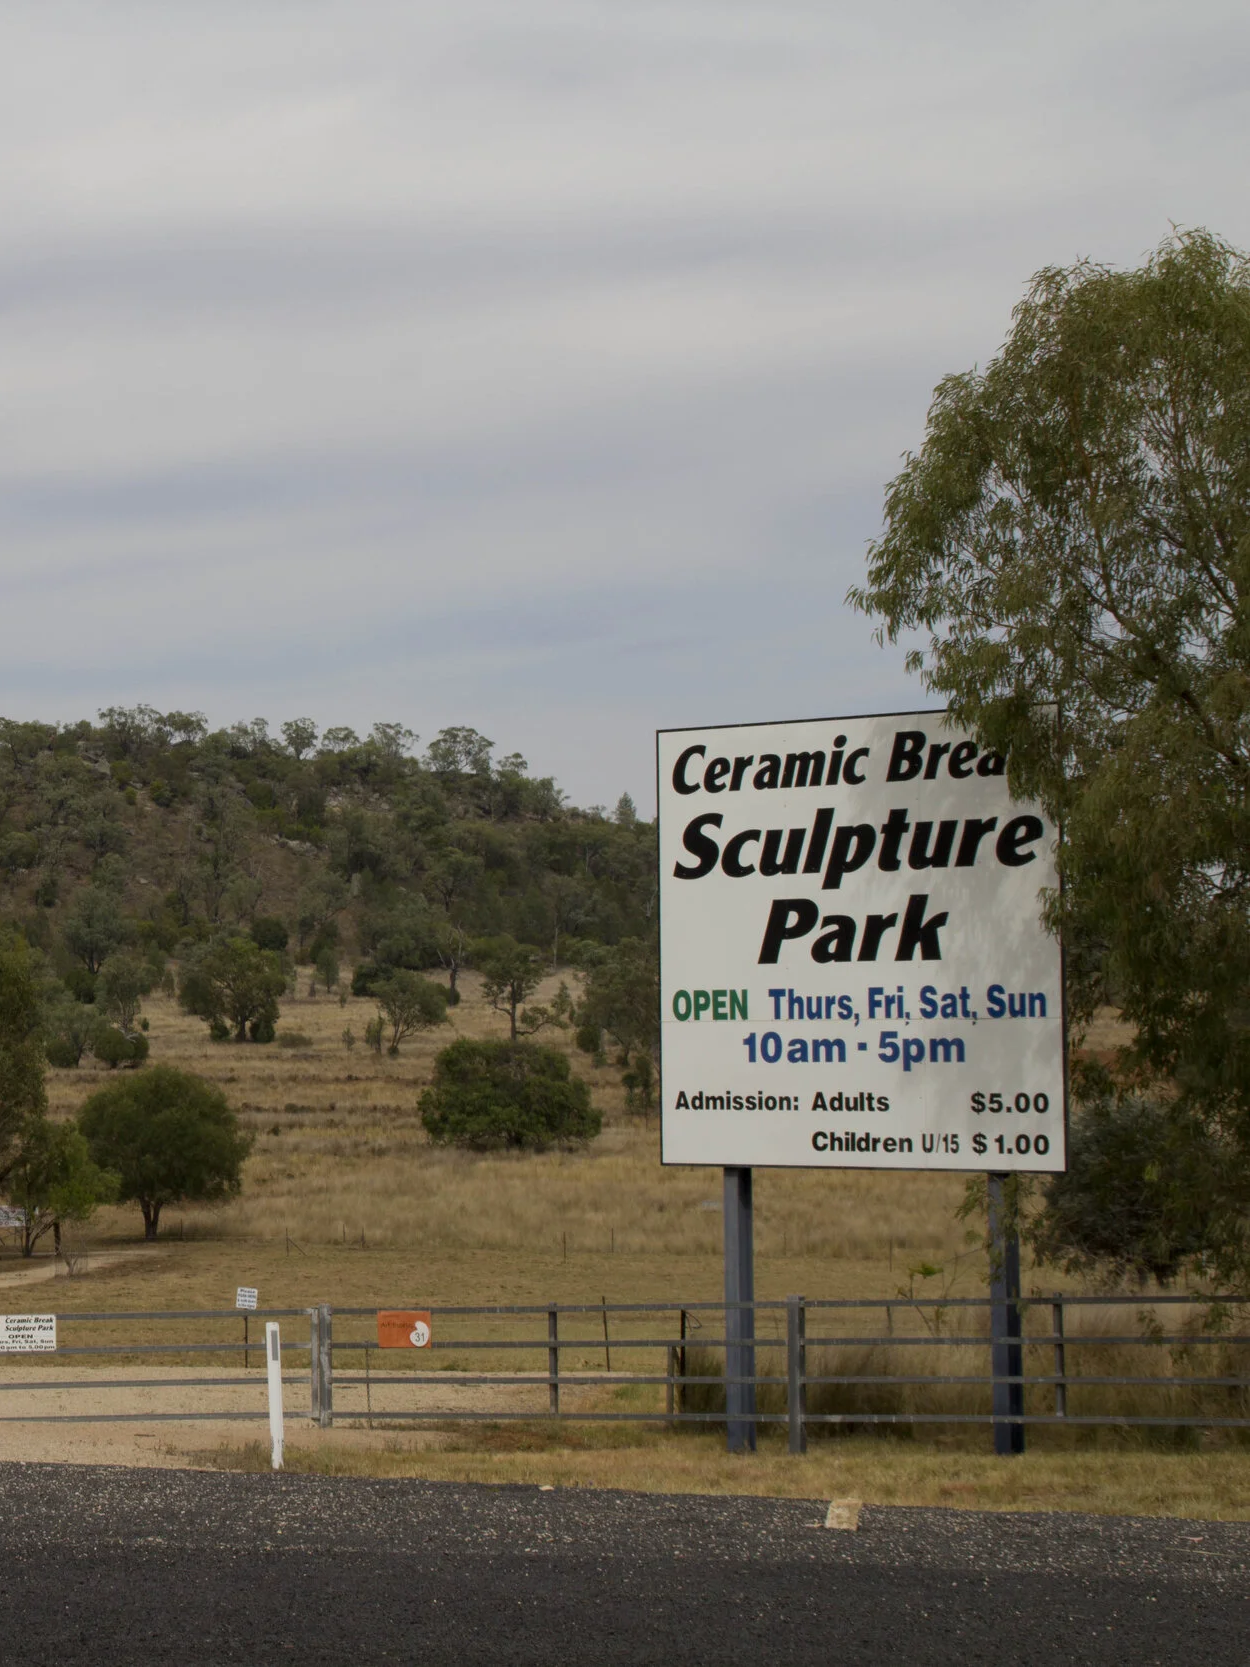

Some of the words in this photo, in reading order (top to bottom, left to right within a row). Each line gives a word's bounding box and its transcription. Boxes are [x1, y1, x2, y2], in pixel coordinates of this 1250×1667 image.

[672, 735, 869, 795] Ceramic
[885, 731, 1007, 783] Brea
[672, 807, 1045, 890] Sculpture
[757, 893, 950, 964] Park
[672, 988, 749, 1022] OPEN
[768, 988, 860, 1027] Thurs,
[868, 986, 912, 1026] Fri,
[920, 985, 979, 1026] Sat,
[986, 984, 1048, 1019] Sun
[878, 1031, 966, 1072] 5pm
[675, 1091, 799, 1113] Admission:
[811, 1091, 890, 1113] Adults
[970, 1091, 1050, 1115] $5.00
[812, 1131, 913, 1154] Children
[921, 1133, 960, 1154] U/15
[415, 1332, 425, 1342] 31
